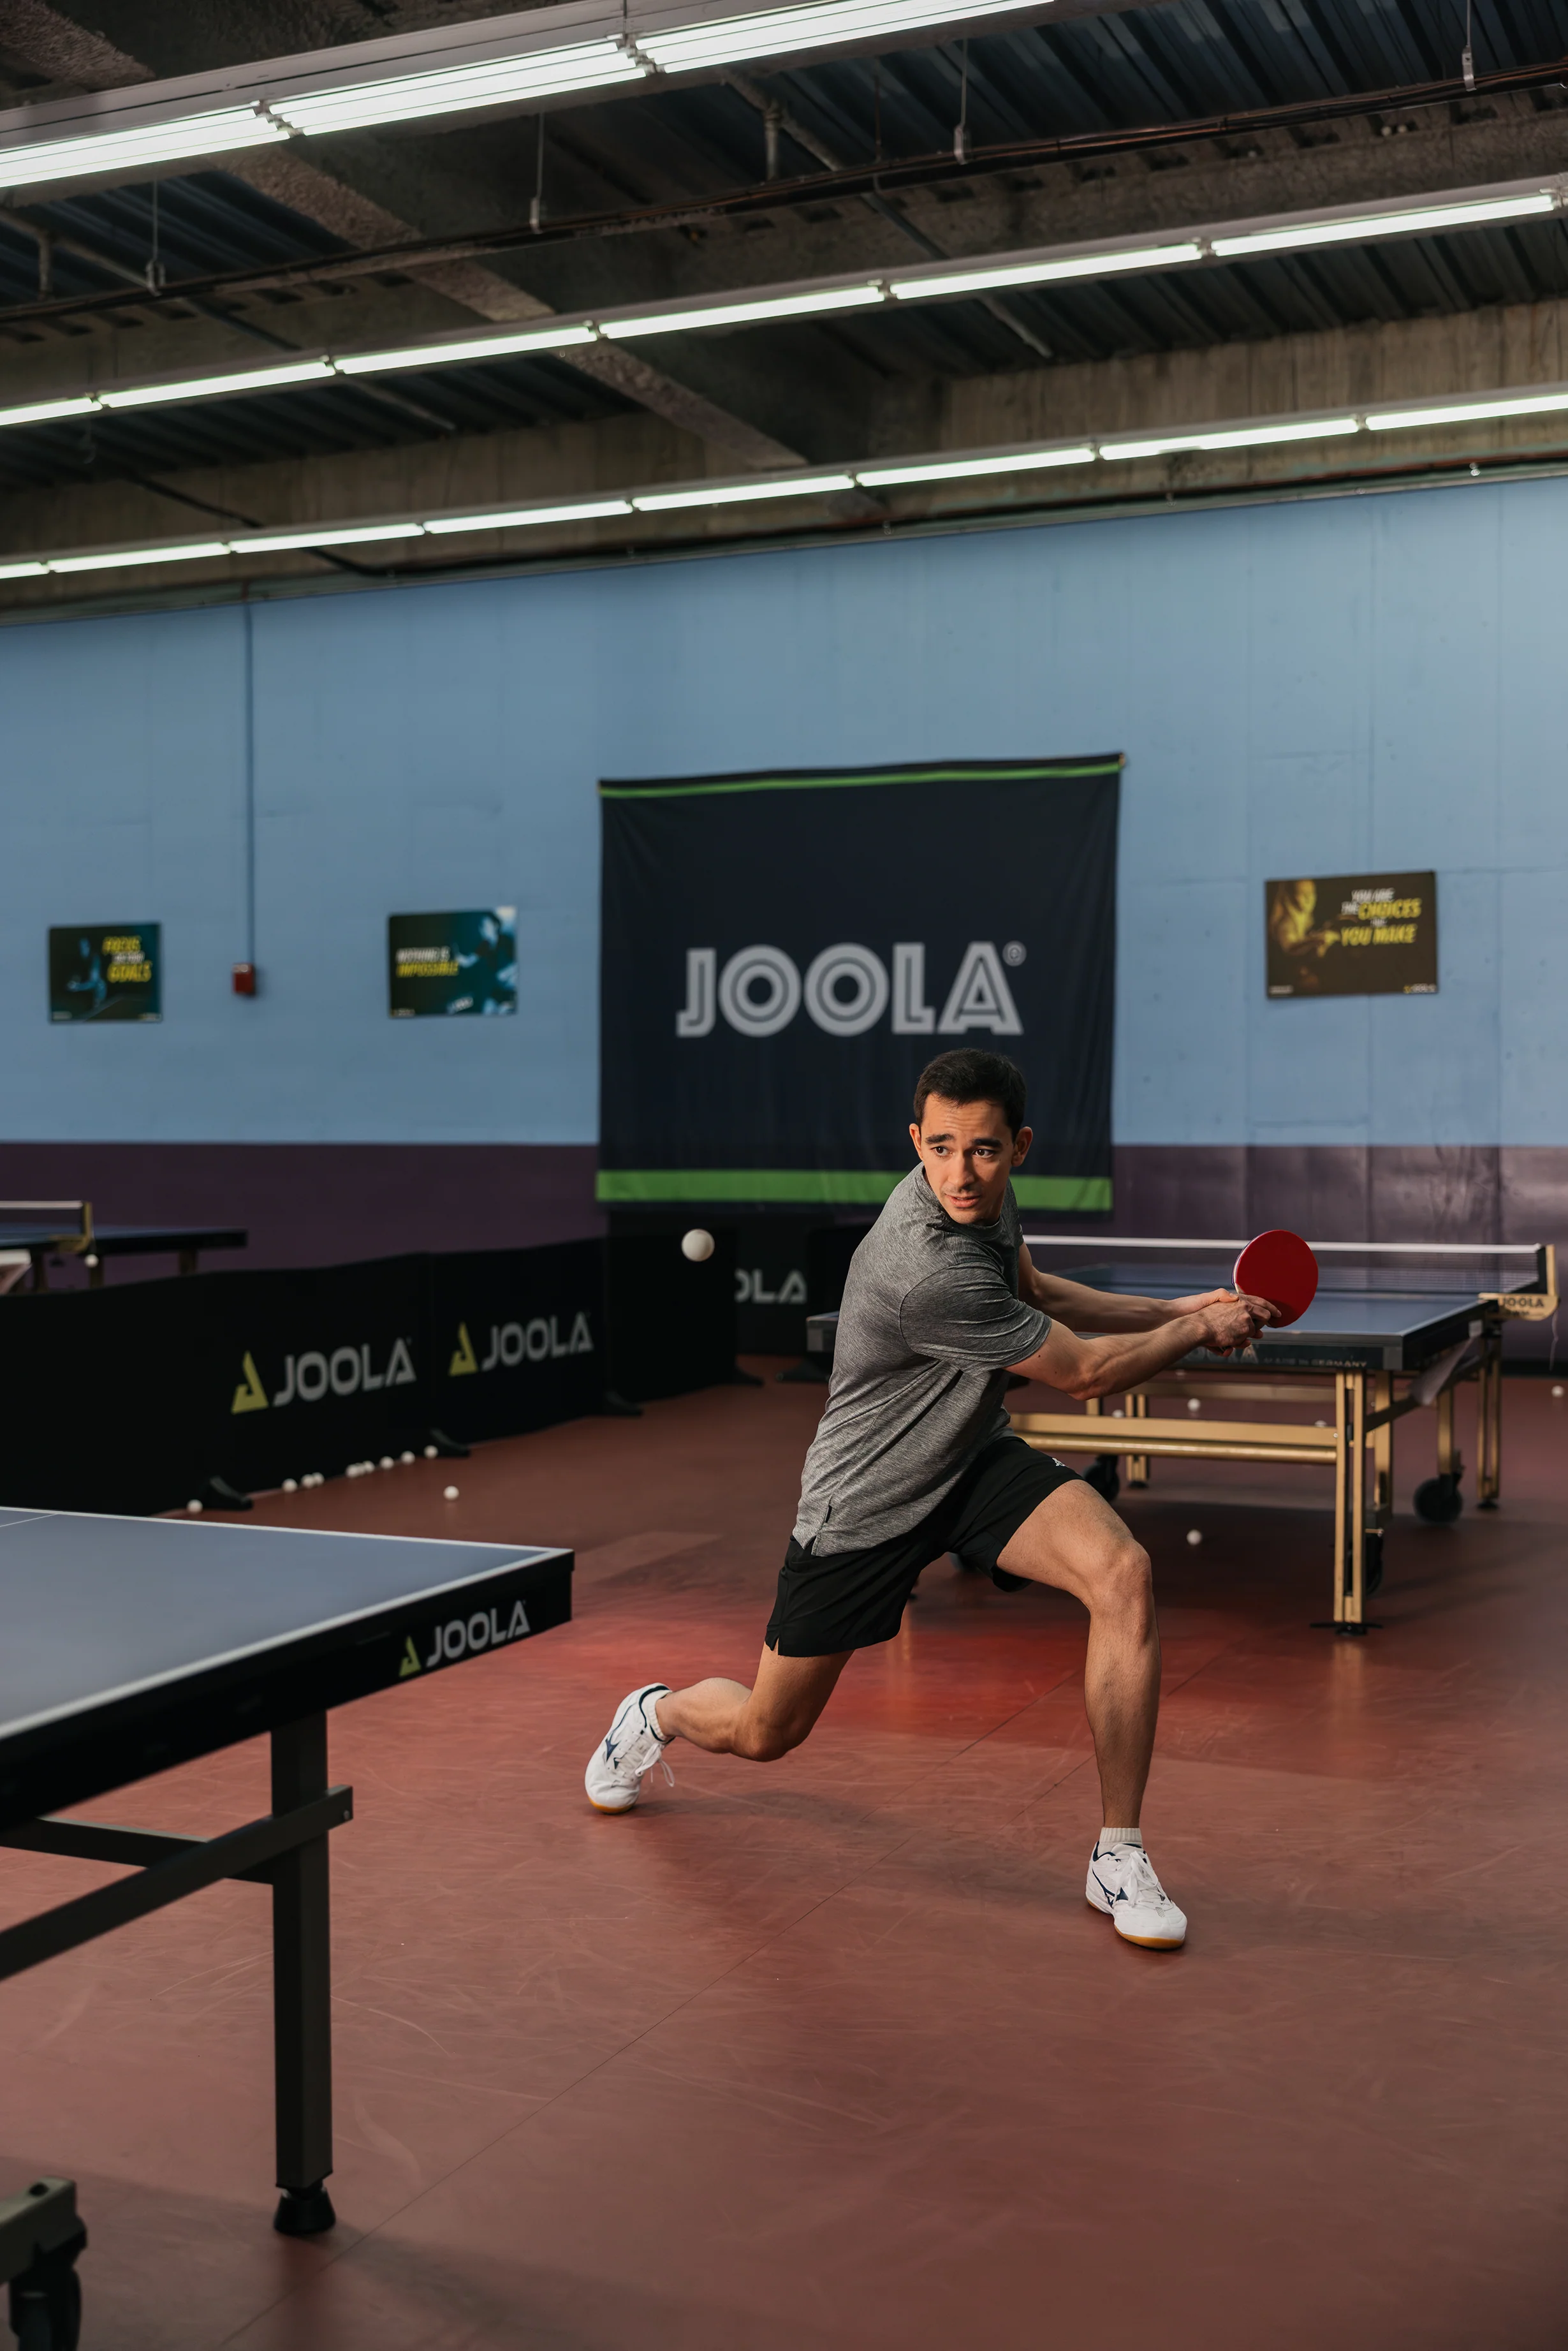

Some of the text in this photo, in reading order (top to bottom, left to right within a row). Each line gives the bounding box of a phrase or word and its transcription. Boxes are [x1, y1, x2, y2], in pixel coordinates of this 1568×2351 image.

[1358, 898, 1422, 920] CHOICES
[1340, 924, 1418, 947] YOU MAKE
[1502, 1297, 1544, 1308] JOOLA
[480, 1311, 594, 1372] JOOLA
[272, 1337, 416, 1407] JOOLA
[1311, 1358, 1368, 1368] GERMANY
[426, 1600, 531, 1668] JOOLA
